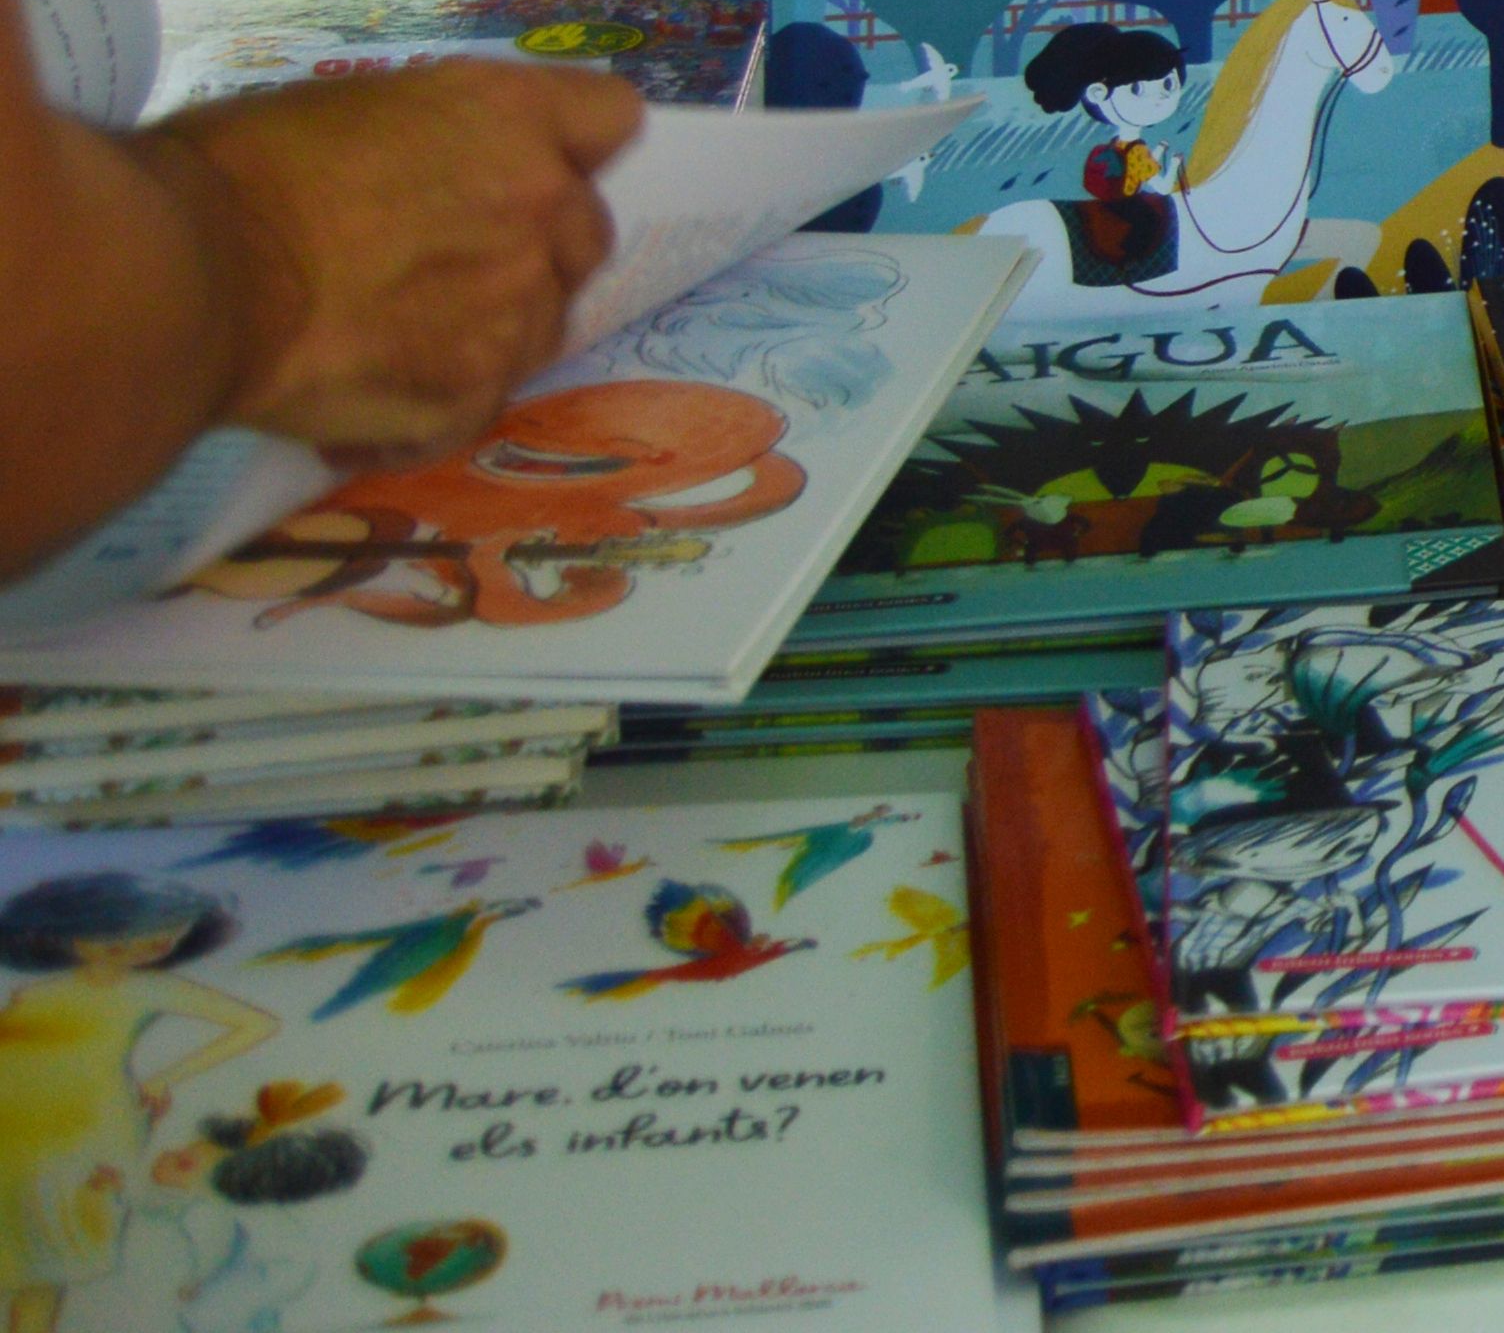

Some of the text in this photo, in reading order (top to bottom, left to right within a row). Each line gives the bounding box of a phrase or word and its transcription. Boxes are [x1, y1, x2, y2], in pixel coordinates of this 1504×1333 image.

[591, 1065, 719, 1104] d'on
[738, 1065, 886, 1093] venen
[448, 1107, 800, 1163] els infants?
